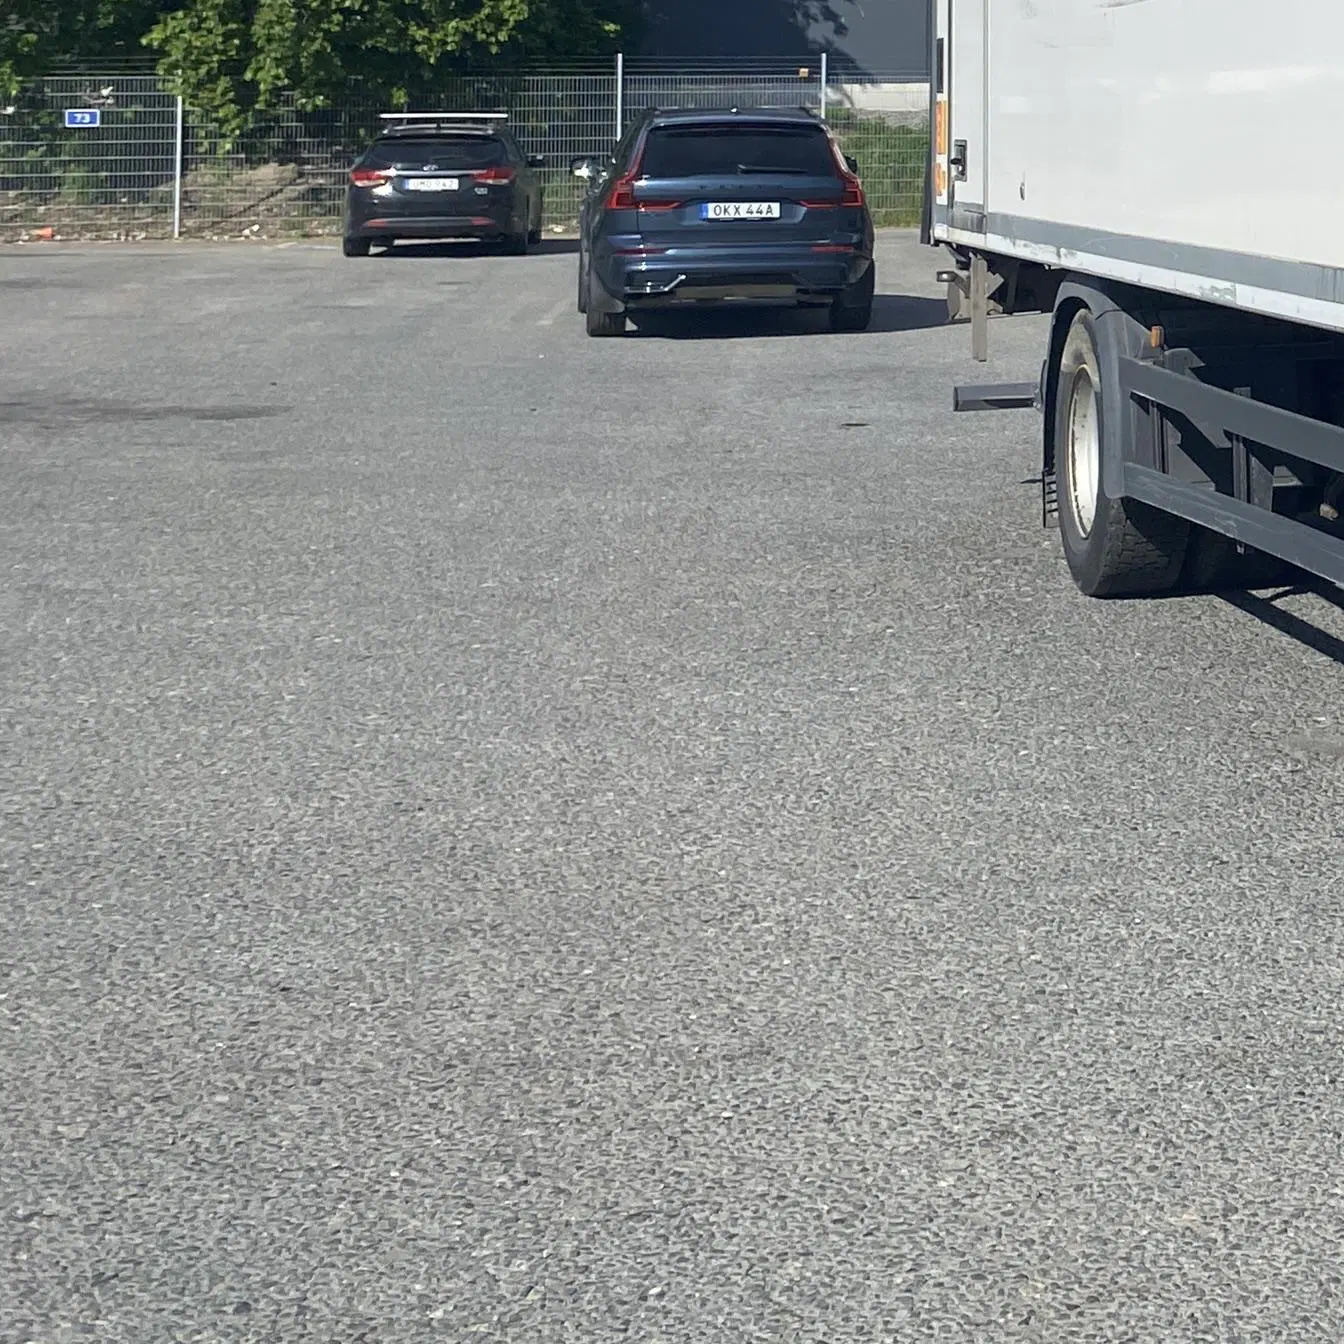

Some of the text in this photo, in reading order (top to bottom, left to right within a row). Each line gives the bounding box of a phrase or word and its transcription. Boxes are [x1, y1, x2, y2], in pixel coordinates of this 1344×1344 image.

[73, 112, 91, 124] 73
[713, 203, 774, 217] OKX 44A
